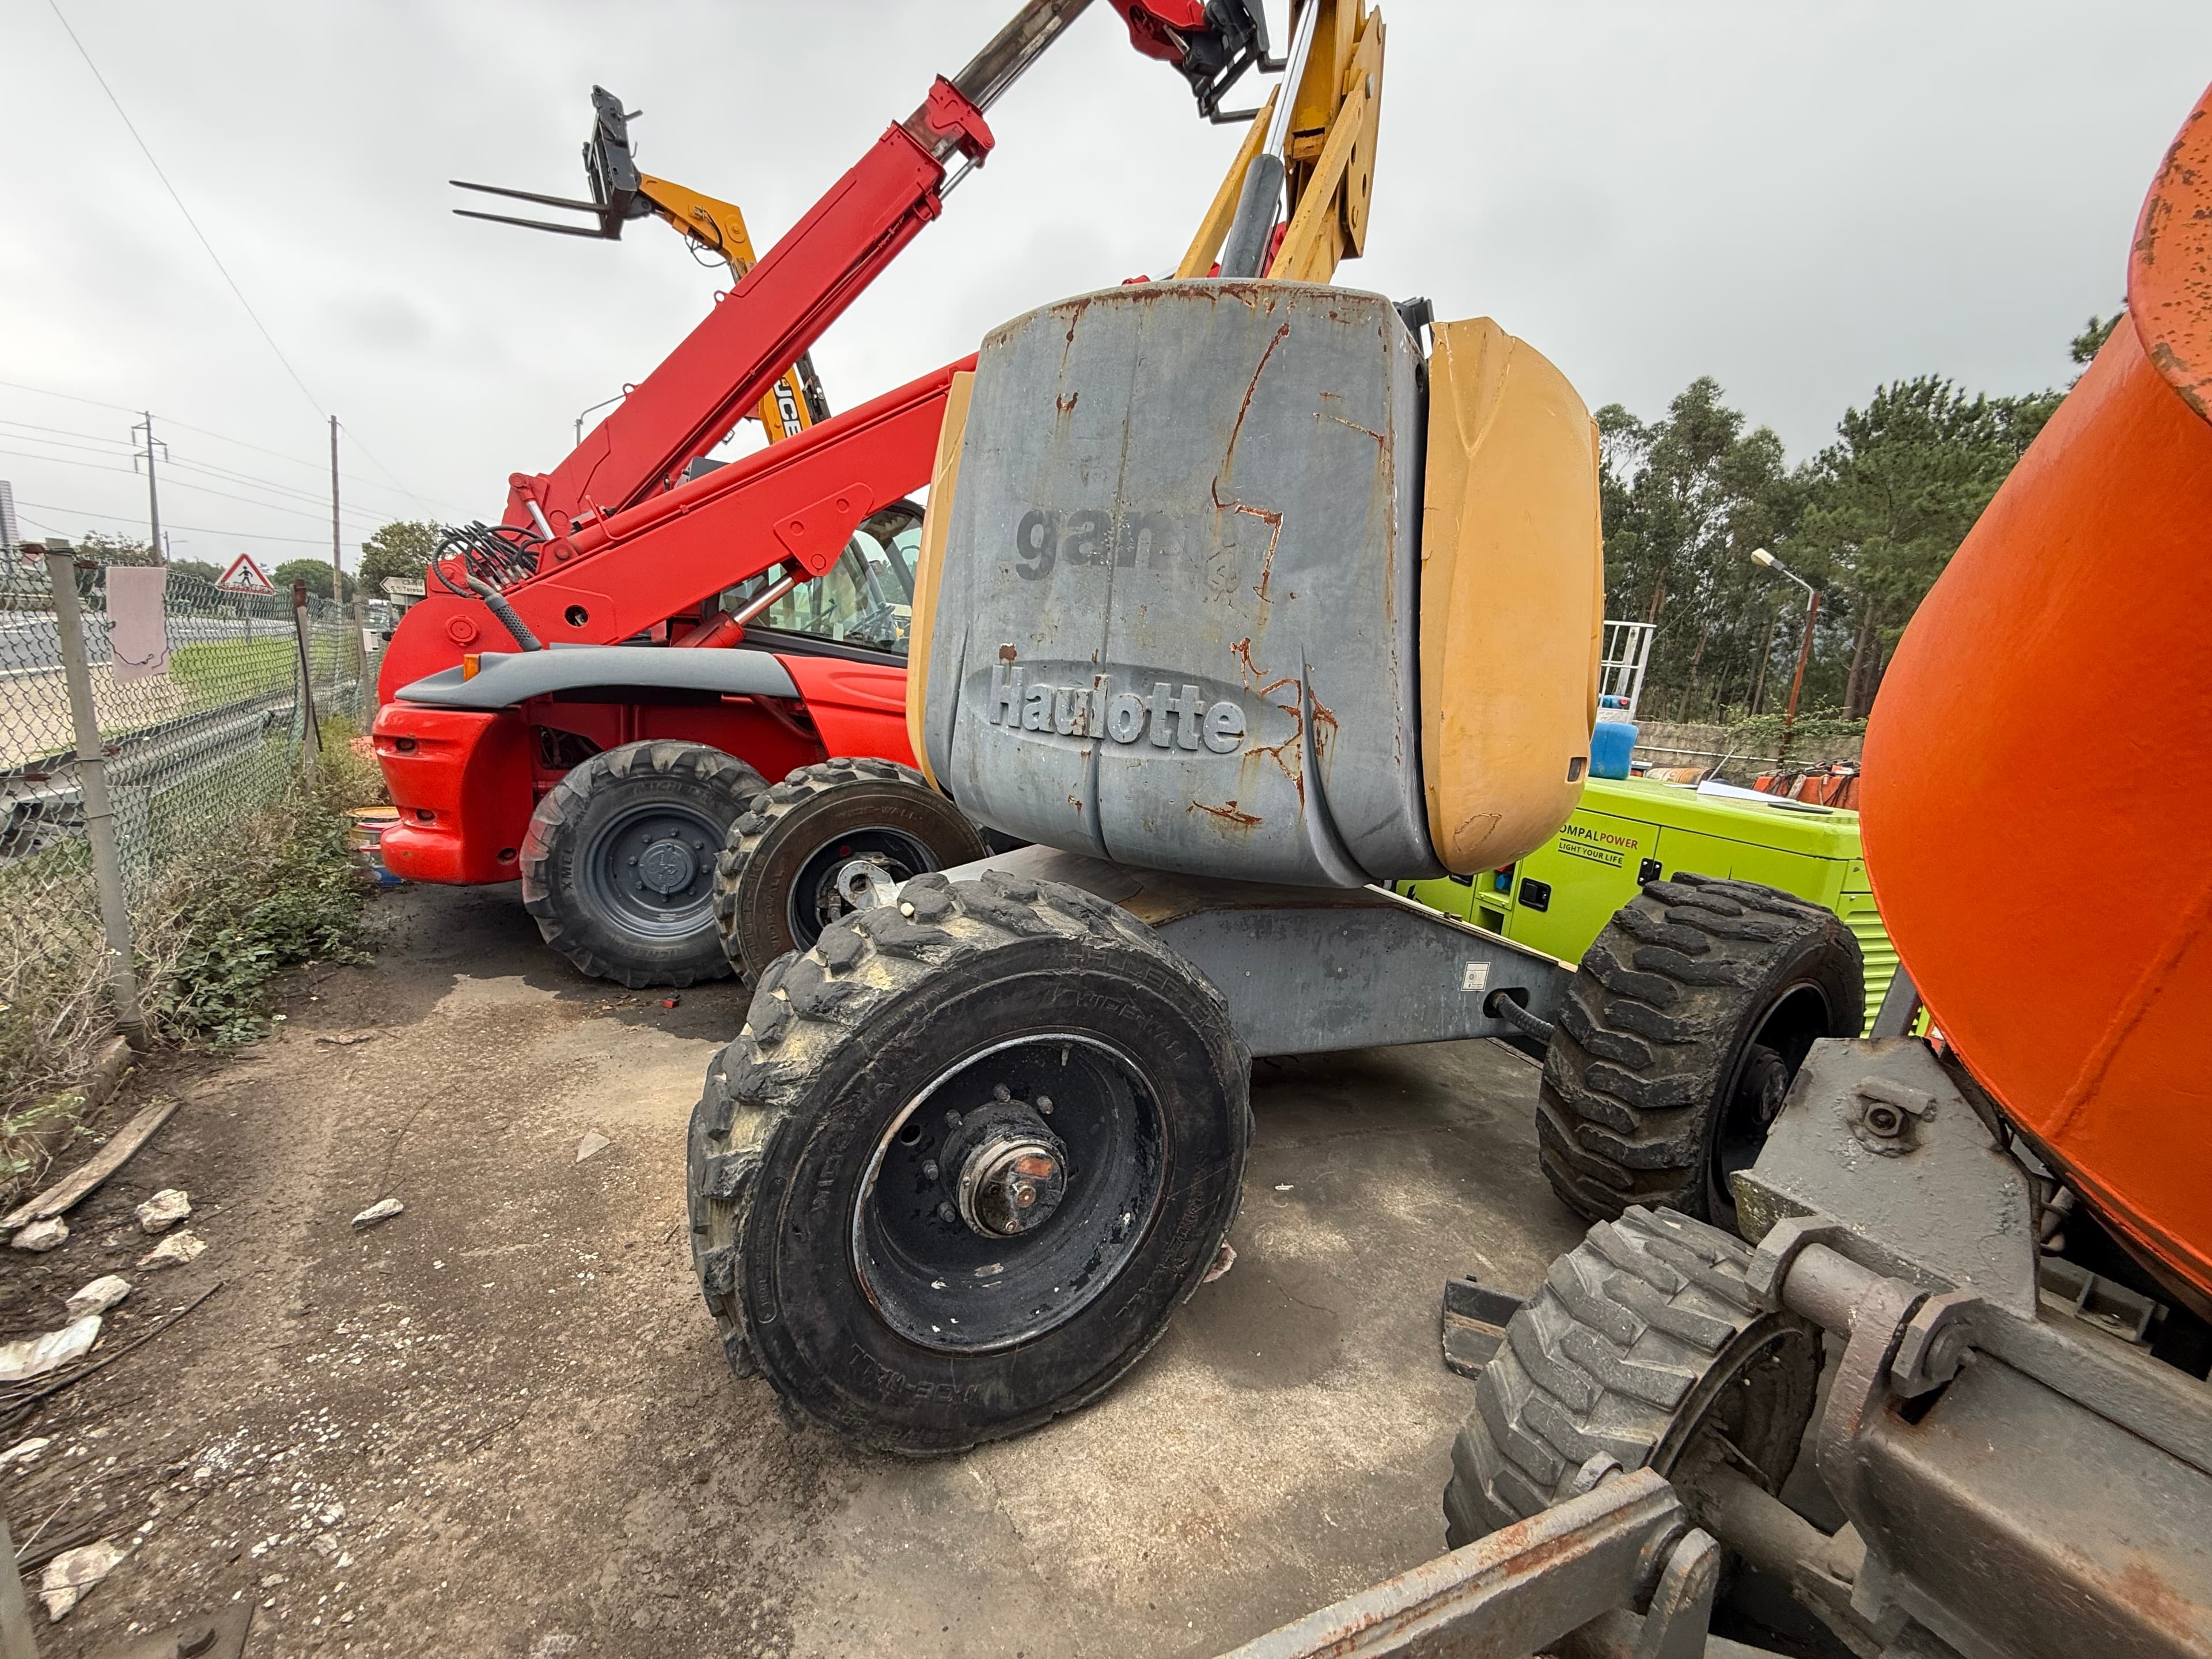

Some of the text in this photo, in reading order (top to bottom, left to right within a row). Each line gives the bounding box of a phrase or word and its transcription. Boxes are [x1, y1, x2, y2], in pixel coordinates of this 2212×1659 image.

[990, 664, 1247, 754] Haulotte
[1559, 824, 1638, 850] OMPALPOWER
[1559, 842, 1623, 865] LIGHT YOUR LIFE
